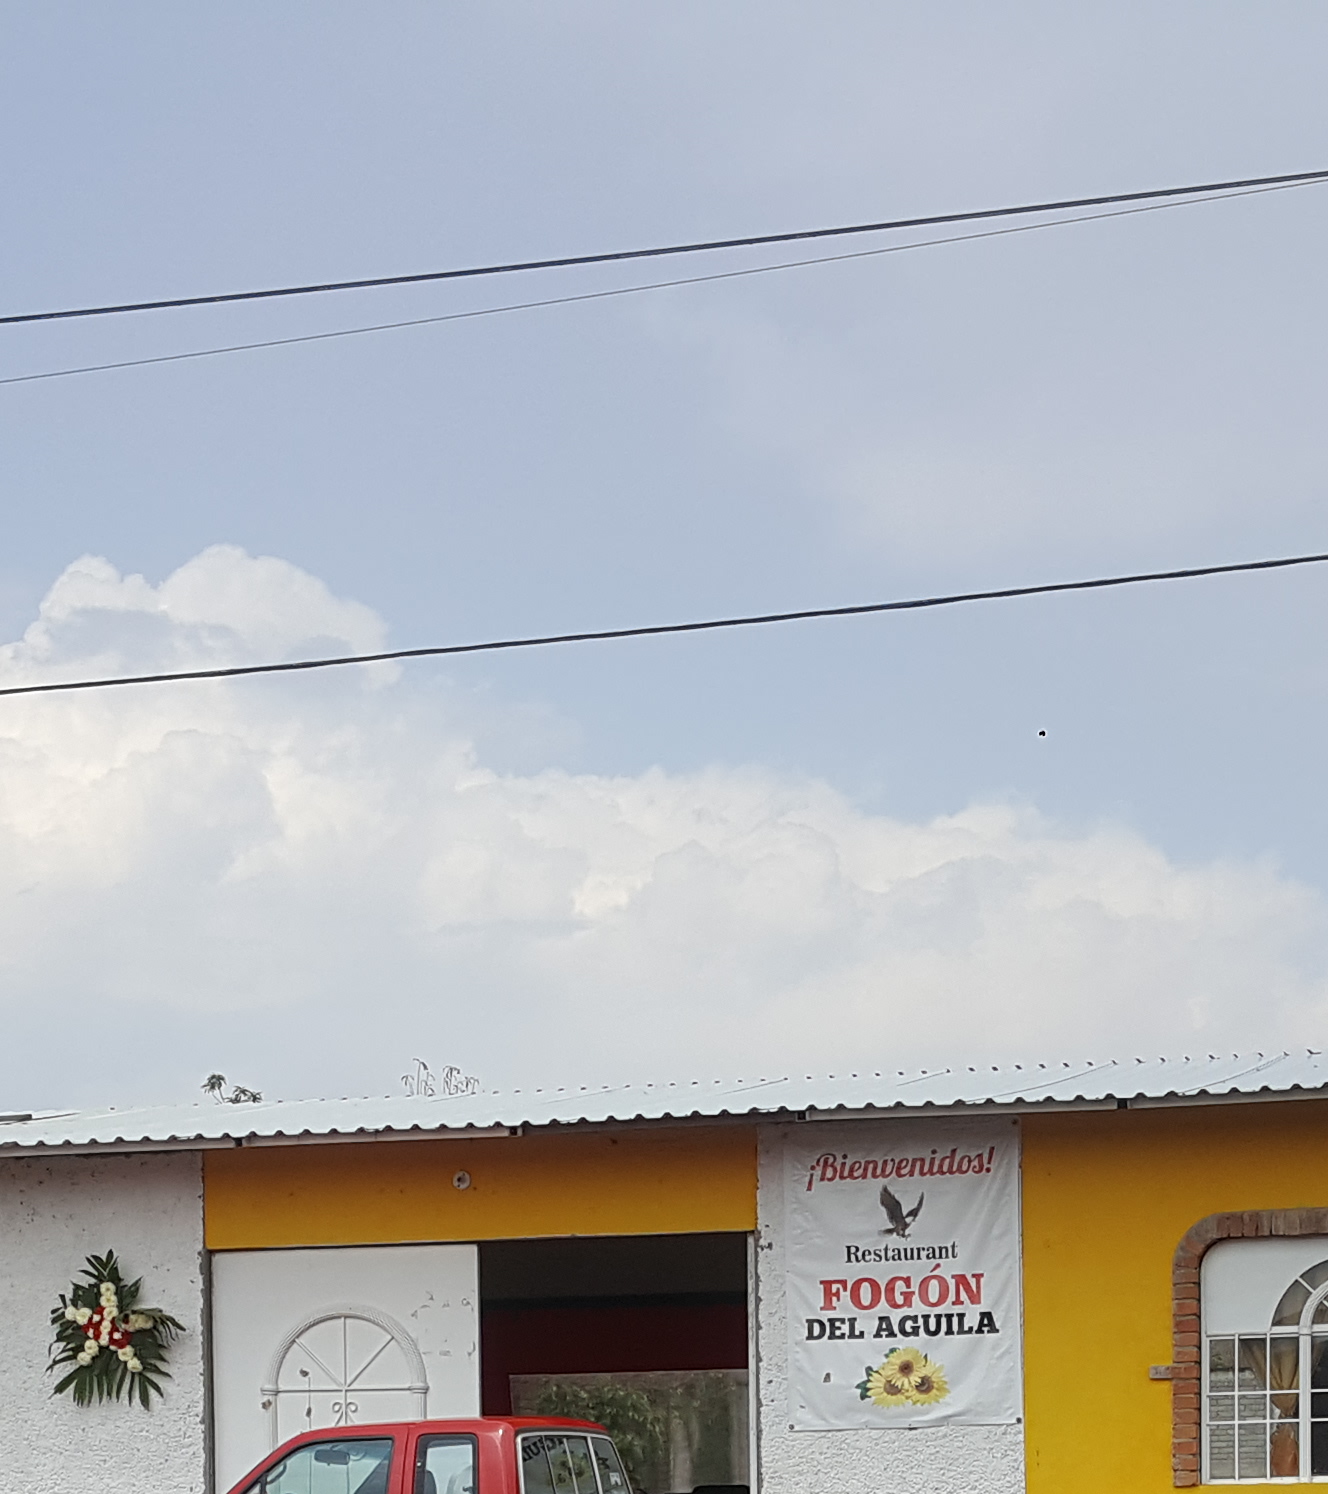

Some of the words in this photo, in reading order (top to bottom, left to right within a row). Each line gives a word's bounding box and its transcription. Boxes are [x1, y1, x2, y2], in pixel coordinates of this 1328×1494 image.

[806, 1146, 996, 1191] ¡Bienvenidos!
[845, 1241, 958, 1264] Restaurant
[819, 1263, 984, 1312] FOGÓN
[805, 1317, 865, 1341] DEL
[873, 1311, 999, 1339] AGUILA
